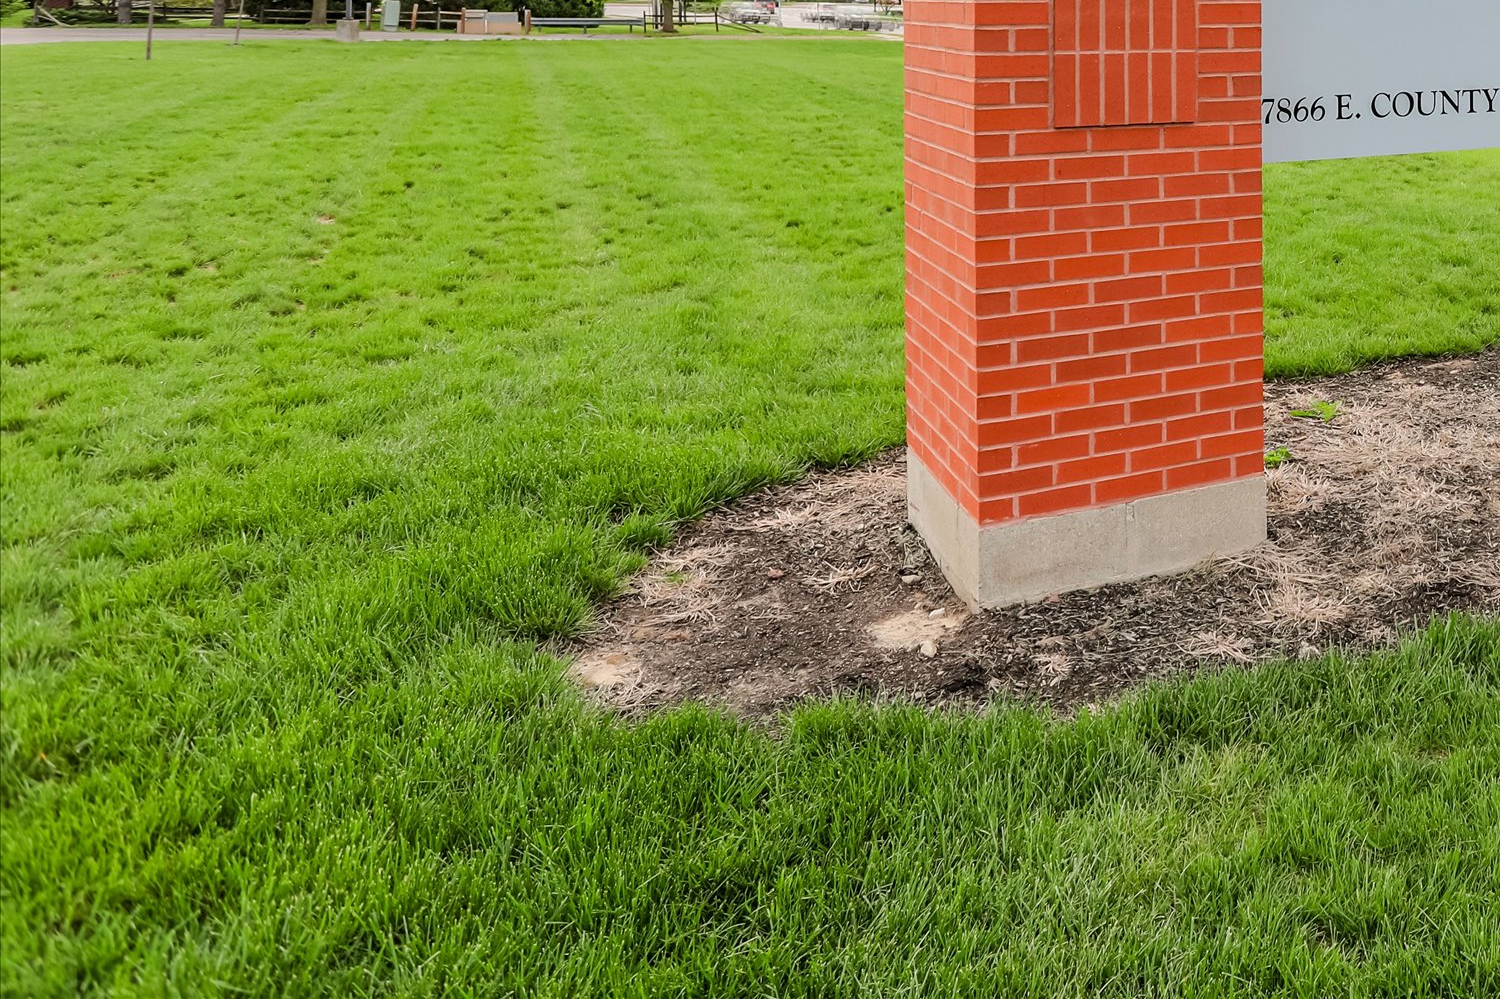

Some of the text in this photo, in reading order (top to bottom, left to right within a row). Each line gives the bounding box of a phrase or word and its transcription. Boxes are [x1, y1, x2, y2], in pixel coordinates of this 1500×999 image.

[1261, 96, 1326, 124] 7866
[1335, 94, 1361, 120] E.
[1370, 87, 1499, 118] COUNTY
